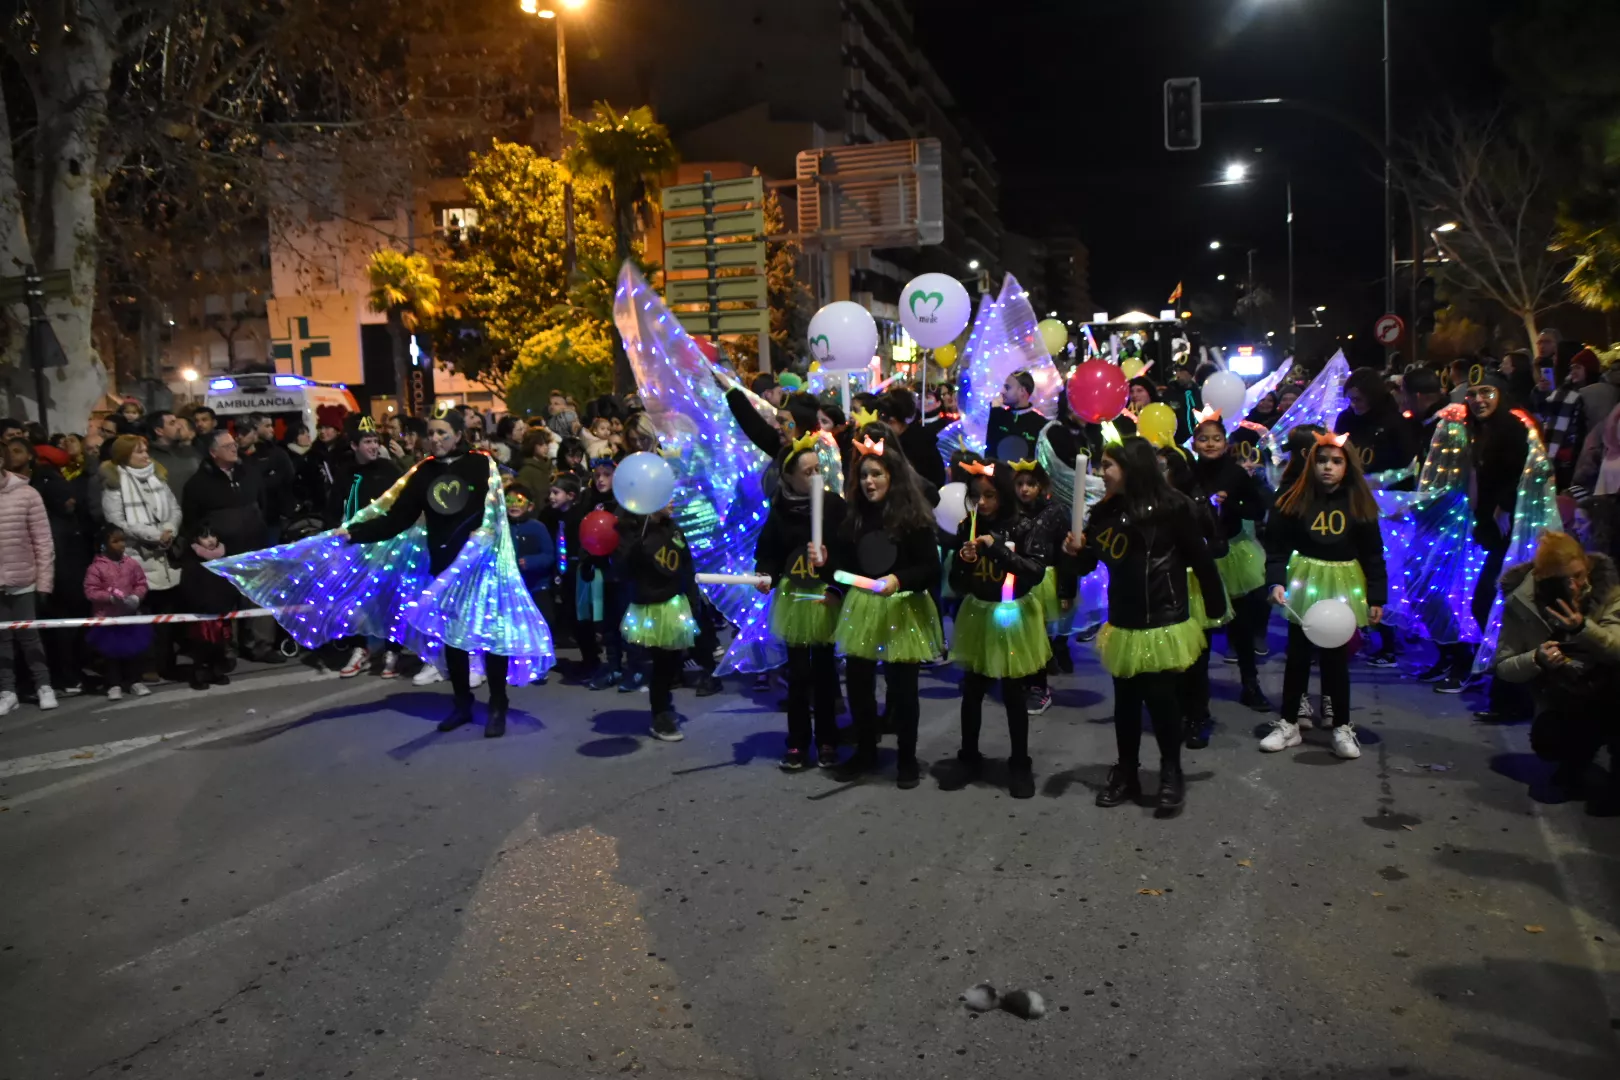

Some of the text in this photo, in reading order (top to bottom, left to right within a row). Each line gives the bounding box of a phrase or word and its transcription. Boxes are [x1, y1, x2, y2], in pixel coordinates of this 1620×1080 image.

[216, 397, 294, 409] AMBULANCIA
[1310, 509, 1346, 536] 40
[1095, 527, 1129, 560] 40
[653, 545, 680, 571] 40
[972, 555, 1005, 583] 40
